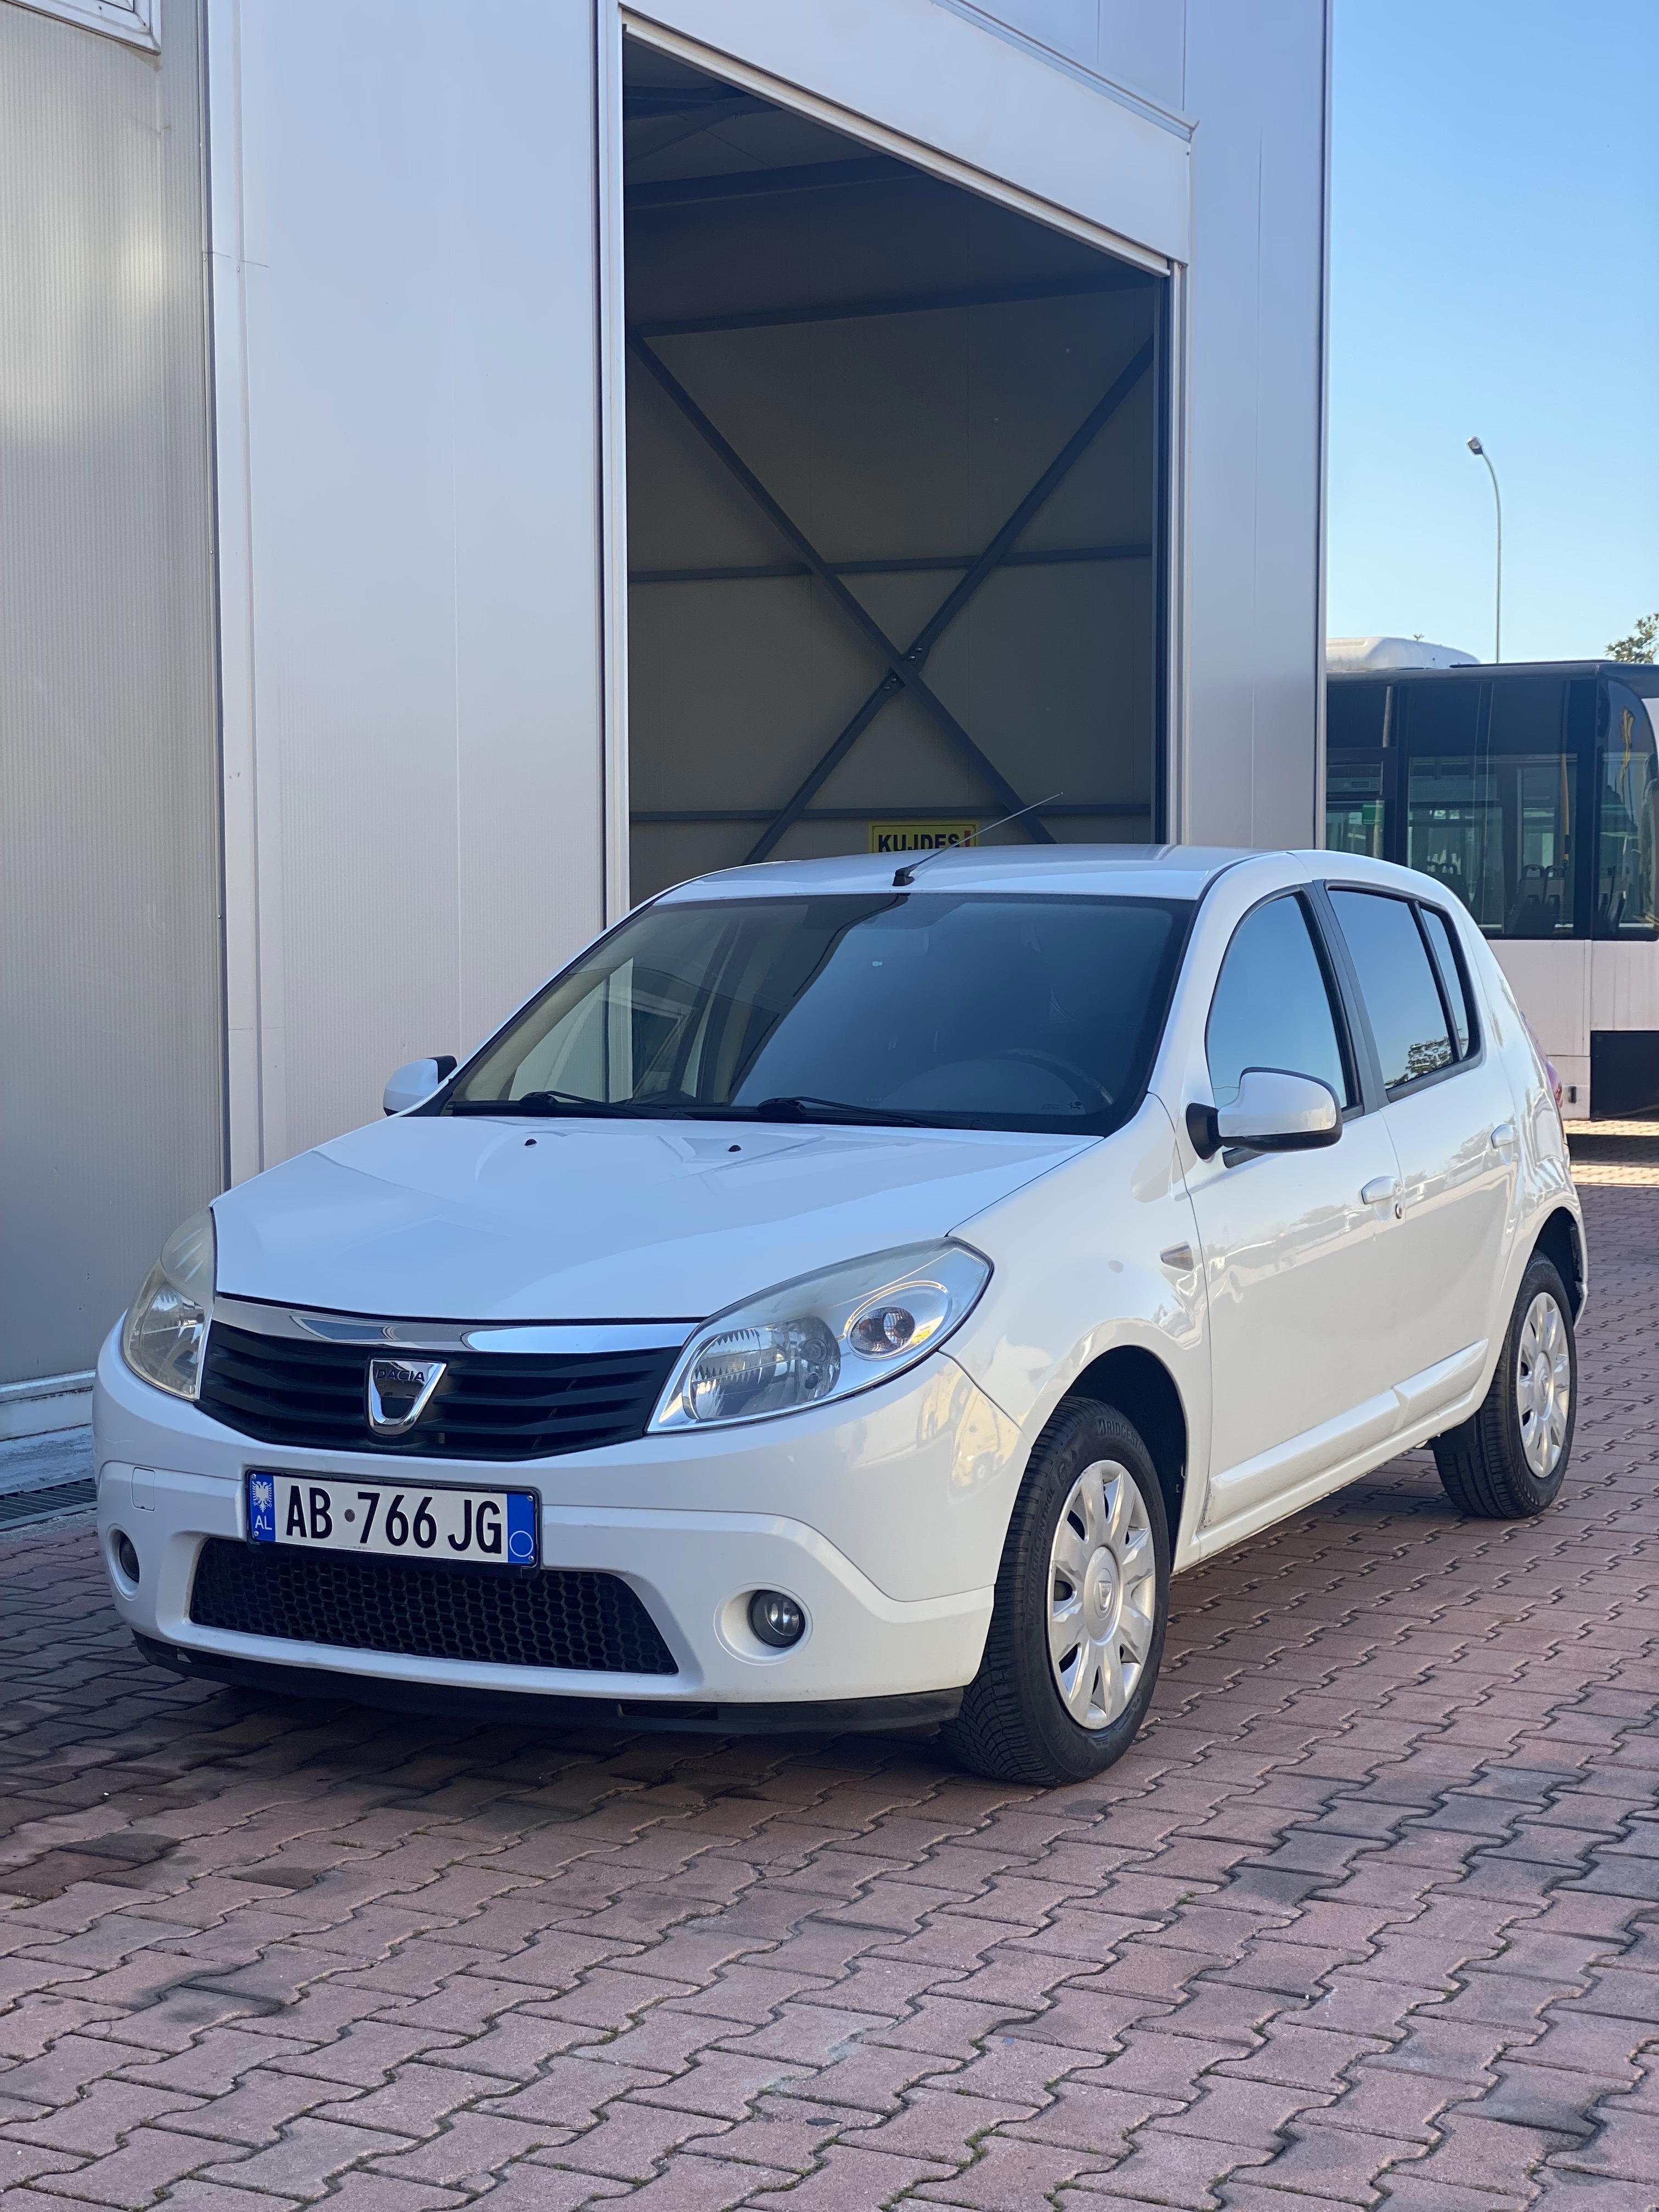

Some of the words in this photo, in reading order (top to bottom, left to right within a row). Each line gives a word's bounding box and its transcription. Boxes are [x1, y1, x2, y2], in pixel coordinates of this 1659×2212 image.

[376, 1369, 425, 1382] DACIA
[255, 1515, 273, 1530] AL
[286, 1485, 333, 1539] AB
[357, 1491, 437, 1548] 766
[447, 1499, 502, 1554] JG
